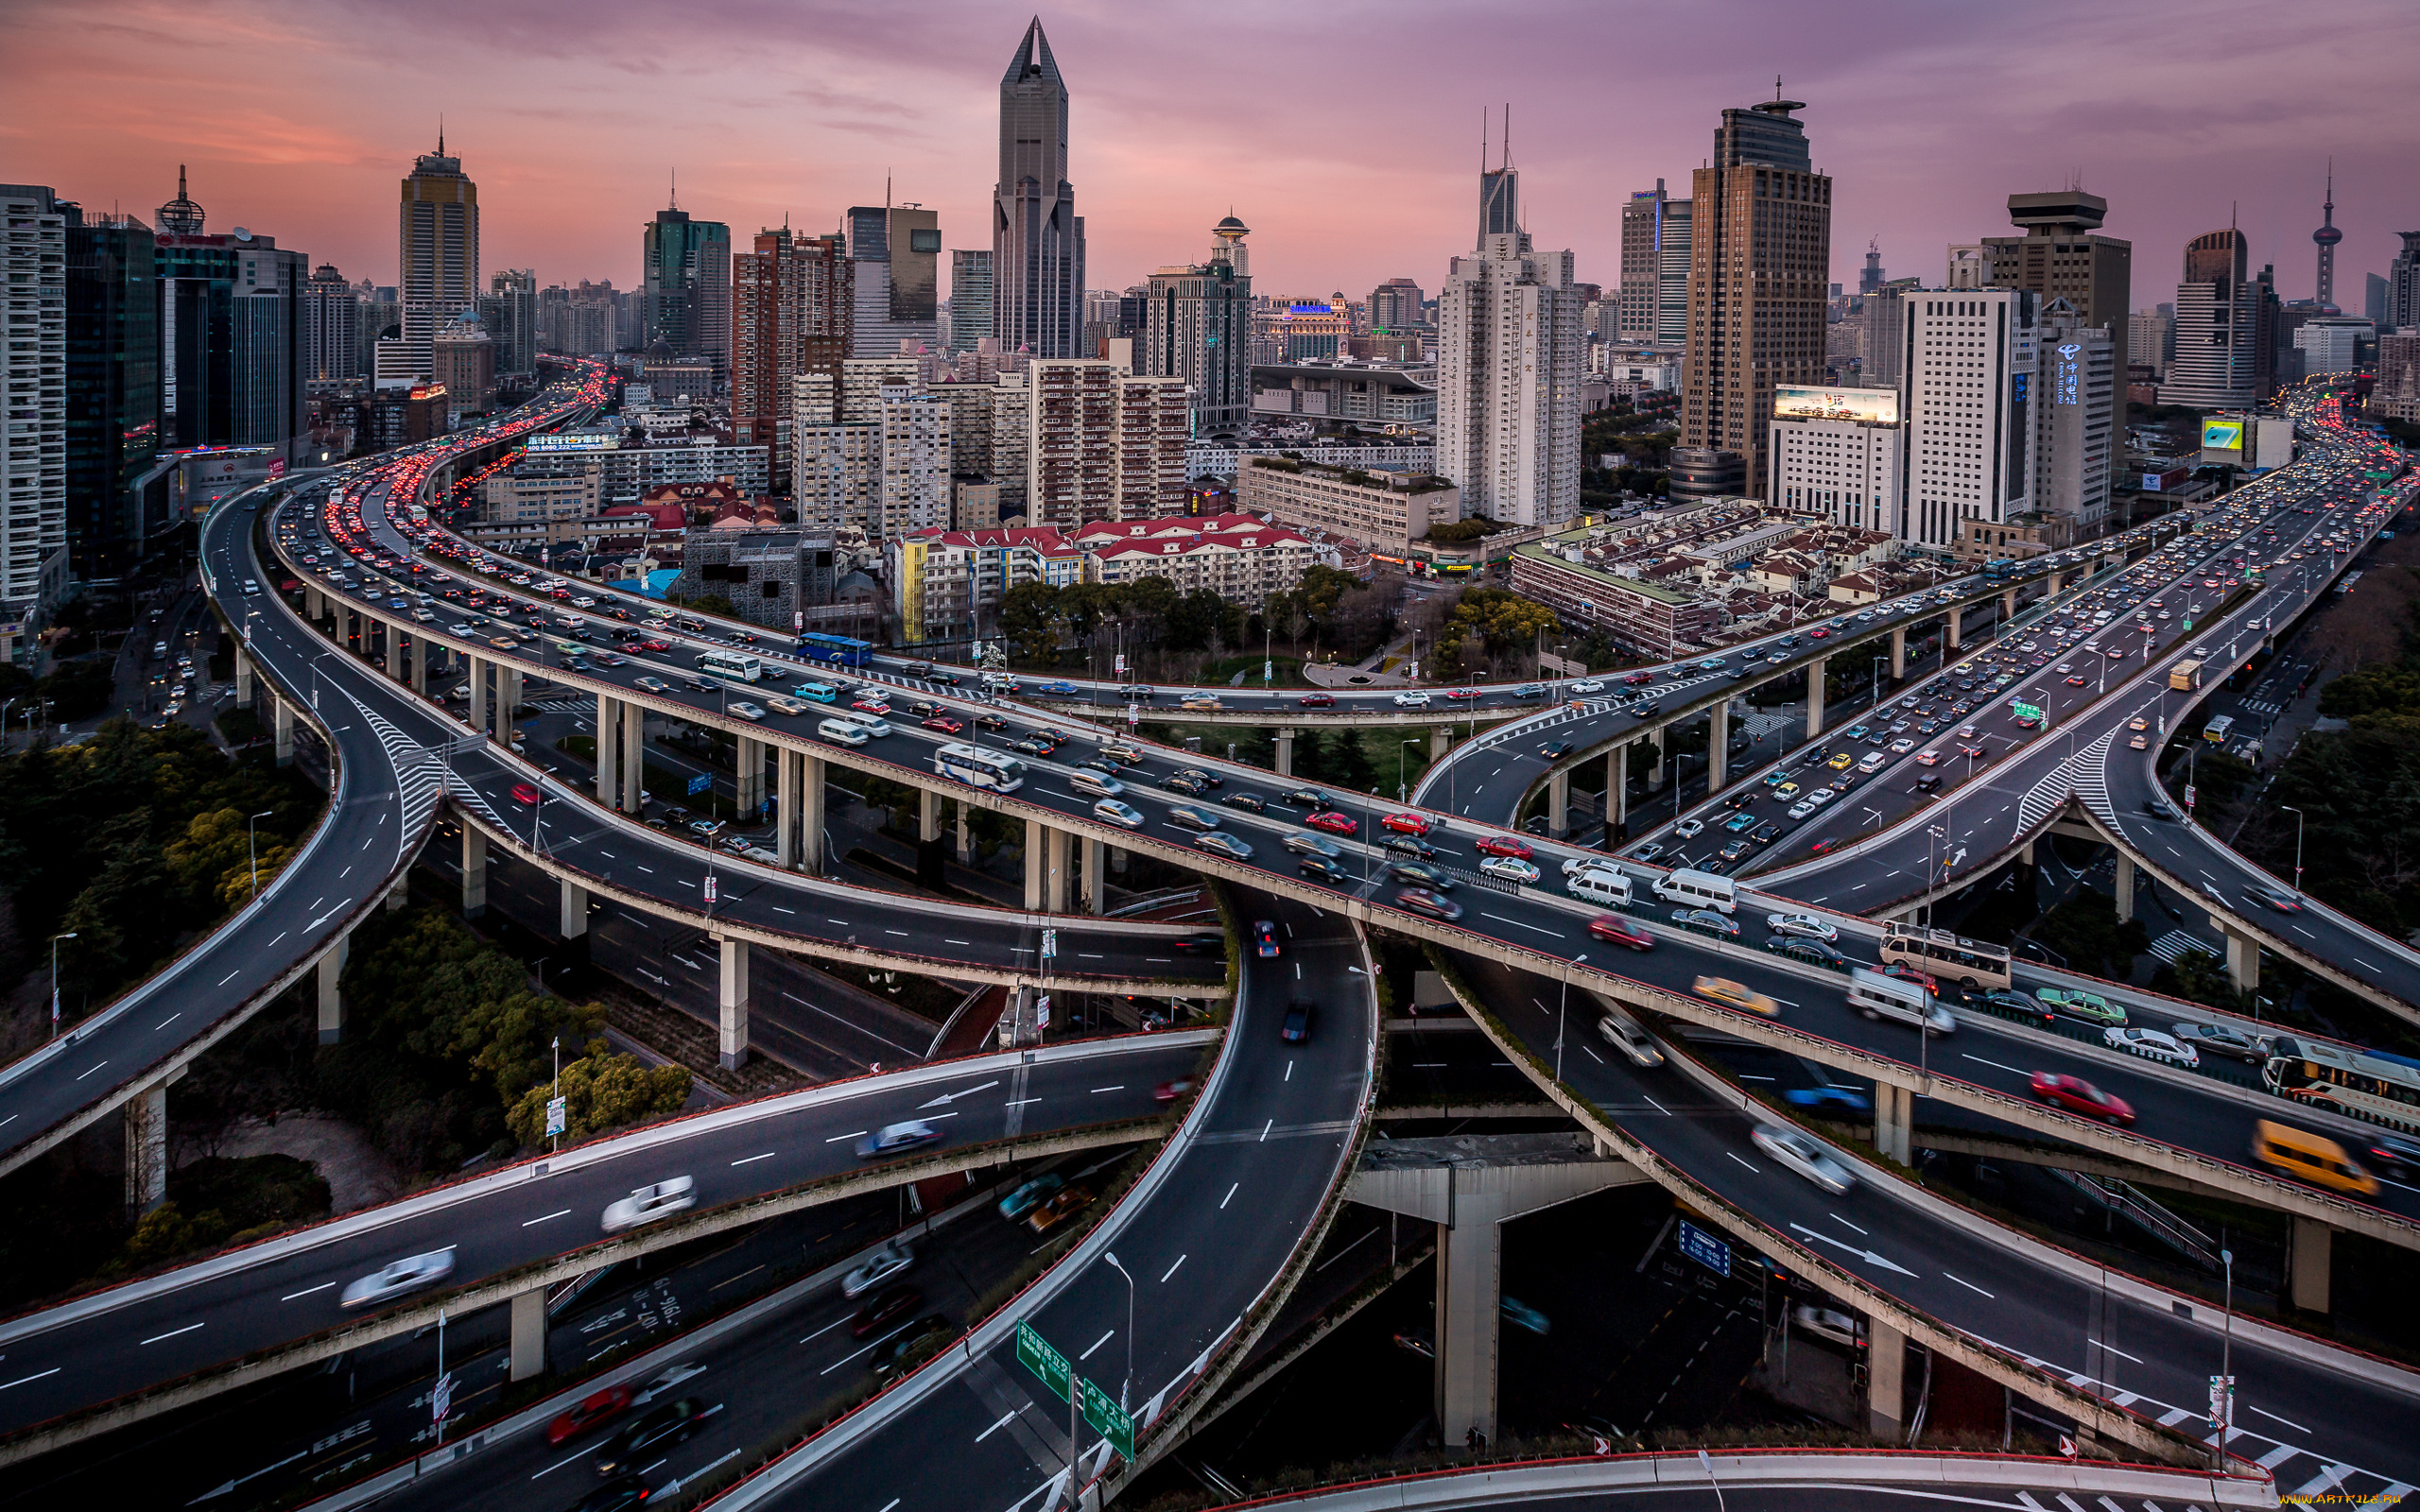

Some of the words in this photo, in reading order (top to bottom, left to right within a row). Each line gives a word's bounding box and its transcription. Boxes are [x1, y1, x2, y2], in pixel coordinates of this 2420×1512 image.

[2066, 362, 2078, 405] 中国电信
[1020, 1325, 1068, 1376] 共和新路立交
[1087, 1386, 1131, 1431] 卢浦大桥
[1089, 1400, 1104, 1417] LUPU
[1106, 1415, 1127, 1437] BRIDGE
